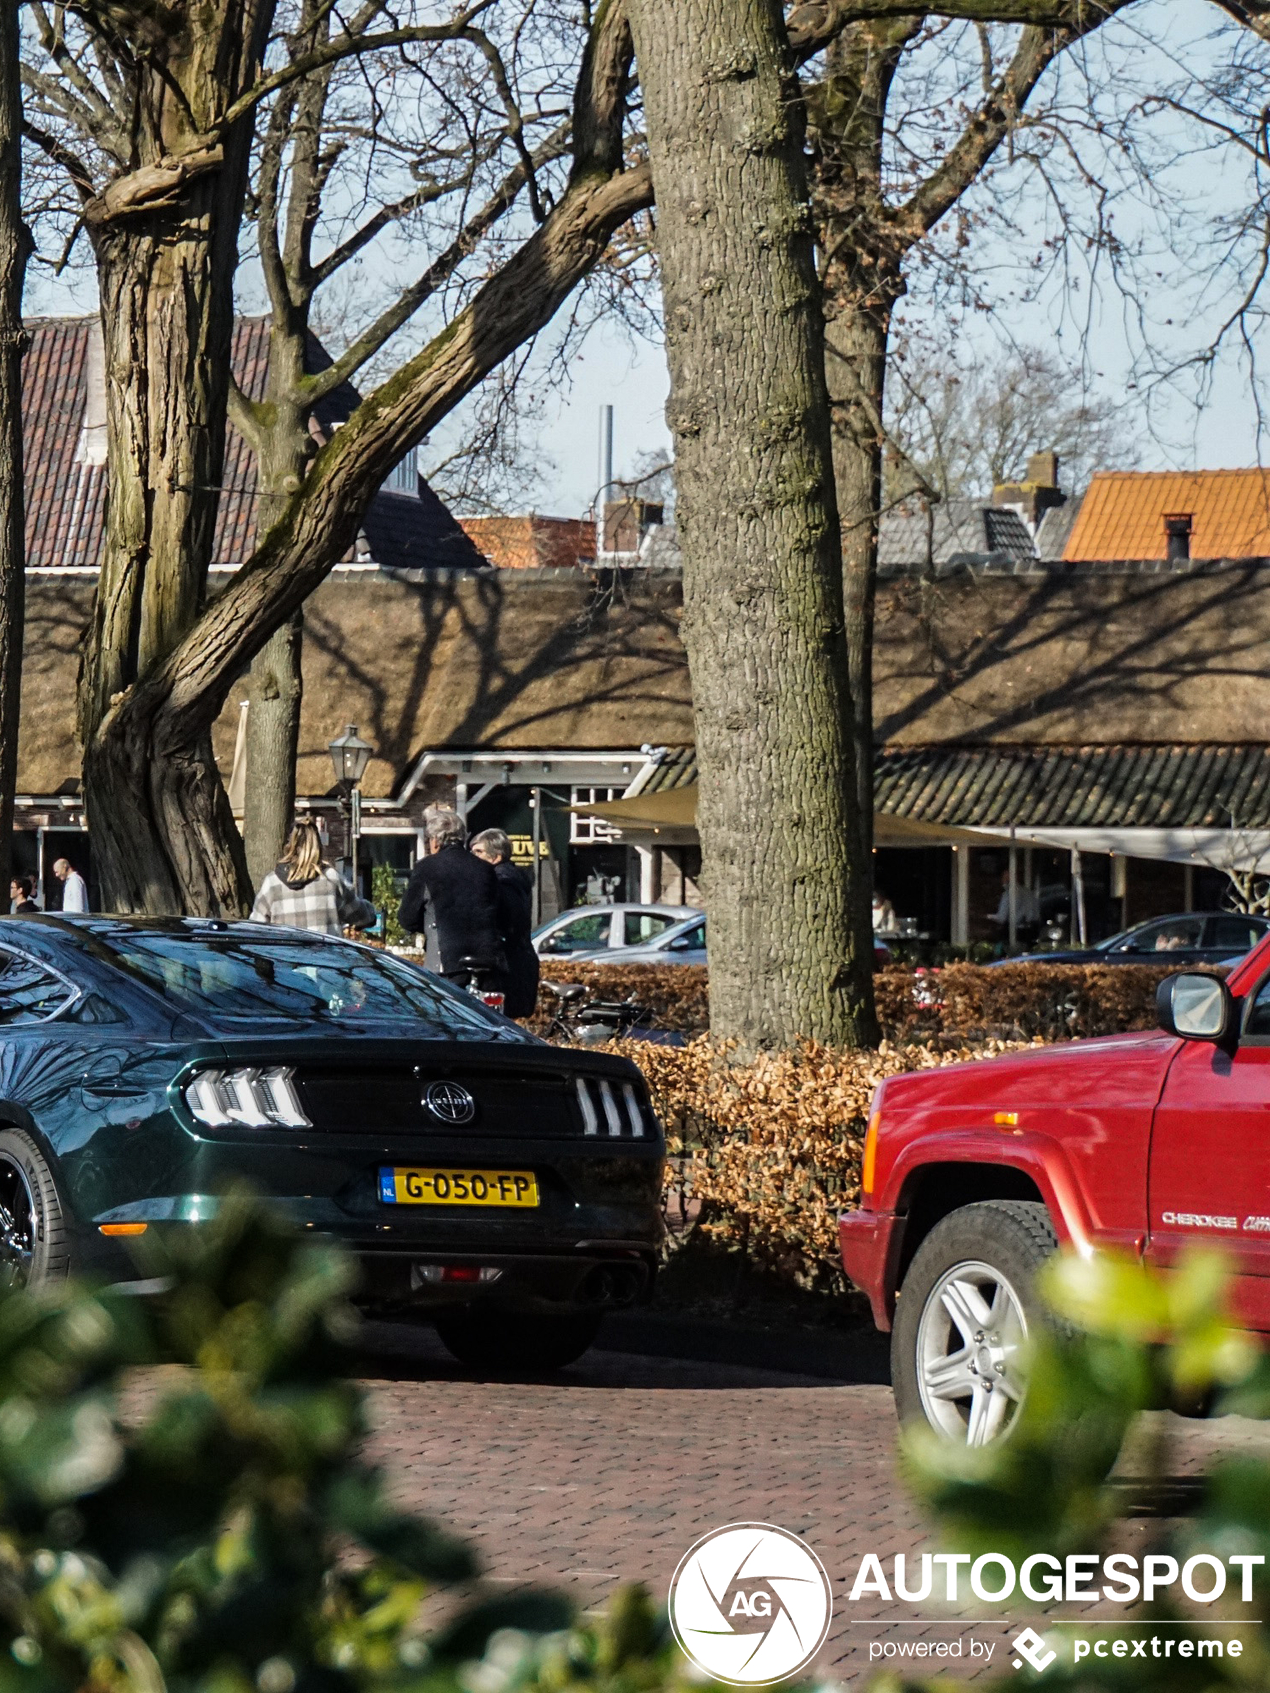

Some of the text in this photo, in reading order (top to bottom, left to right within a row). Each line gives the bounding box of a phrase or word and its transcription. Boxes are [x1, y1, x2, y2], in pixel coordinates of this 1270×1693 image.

[382, 1187, 395, 1198] NL
[405, 1171, 530, 1201] G-050-FP
[1162, 1211, 1237, 1228] CHEROKEE
